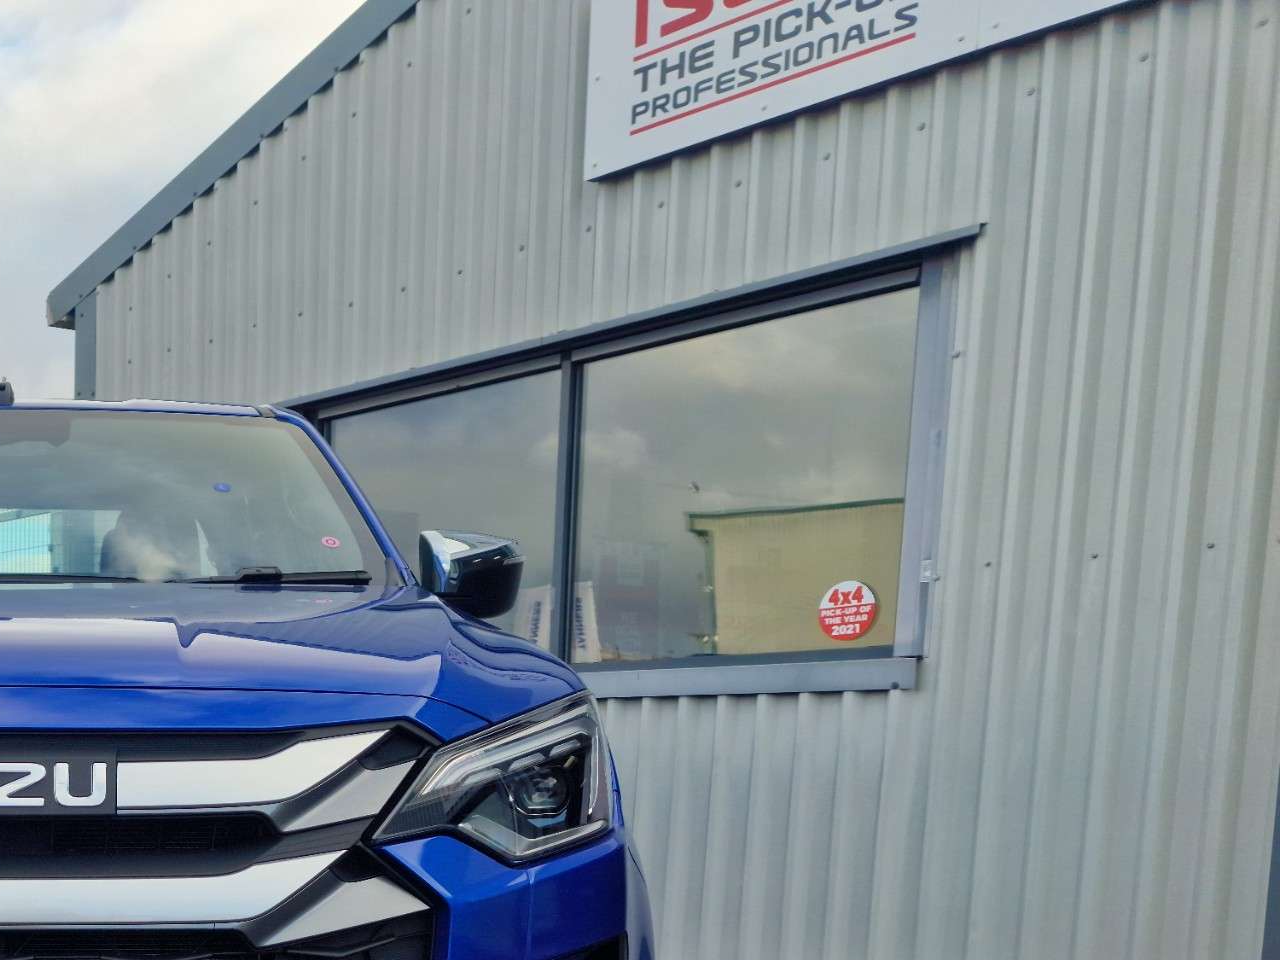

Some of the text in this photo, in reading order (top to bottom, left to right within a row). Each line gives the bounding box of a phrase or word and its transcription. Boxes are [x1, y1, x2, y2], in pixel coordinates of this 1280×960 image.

[631, 2, 919, 125] PROFESSIONALS
[633, 40, 715, 92] THE
[828, 585, 864, 606] 4x4
[821, 605, 872, 617] PICK-UP OF
[824, 614, 868, 625] THE YEAR
[832, 623, 861, 636] 2021
